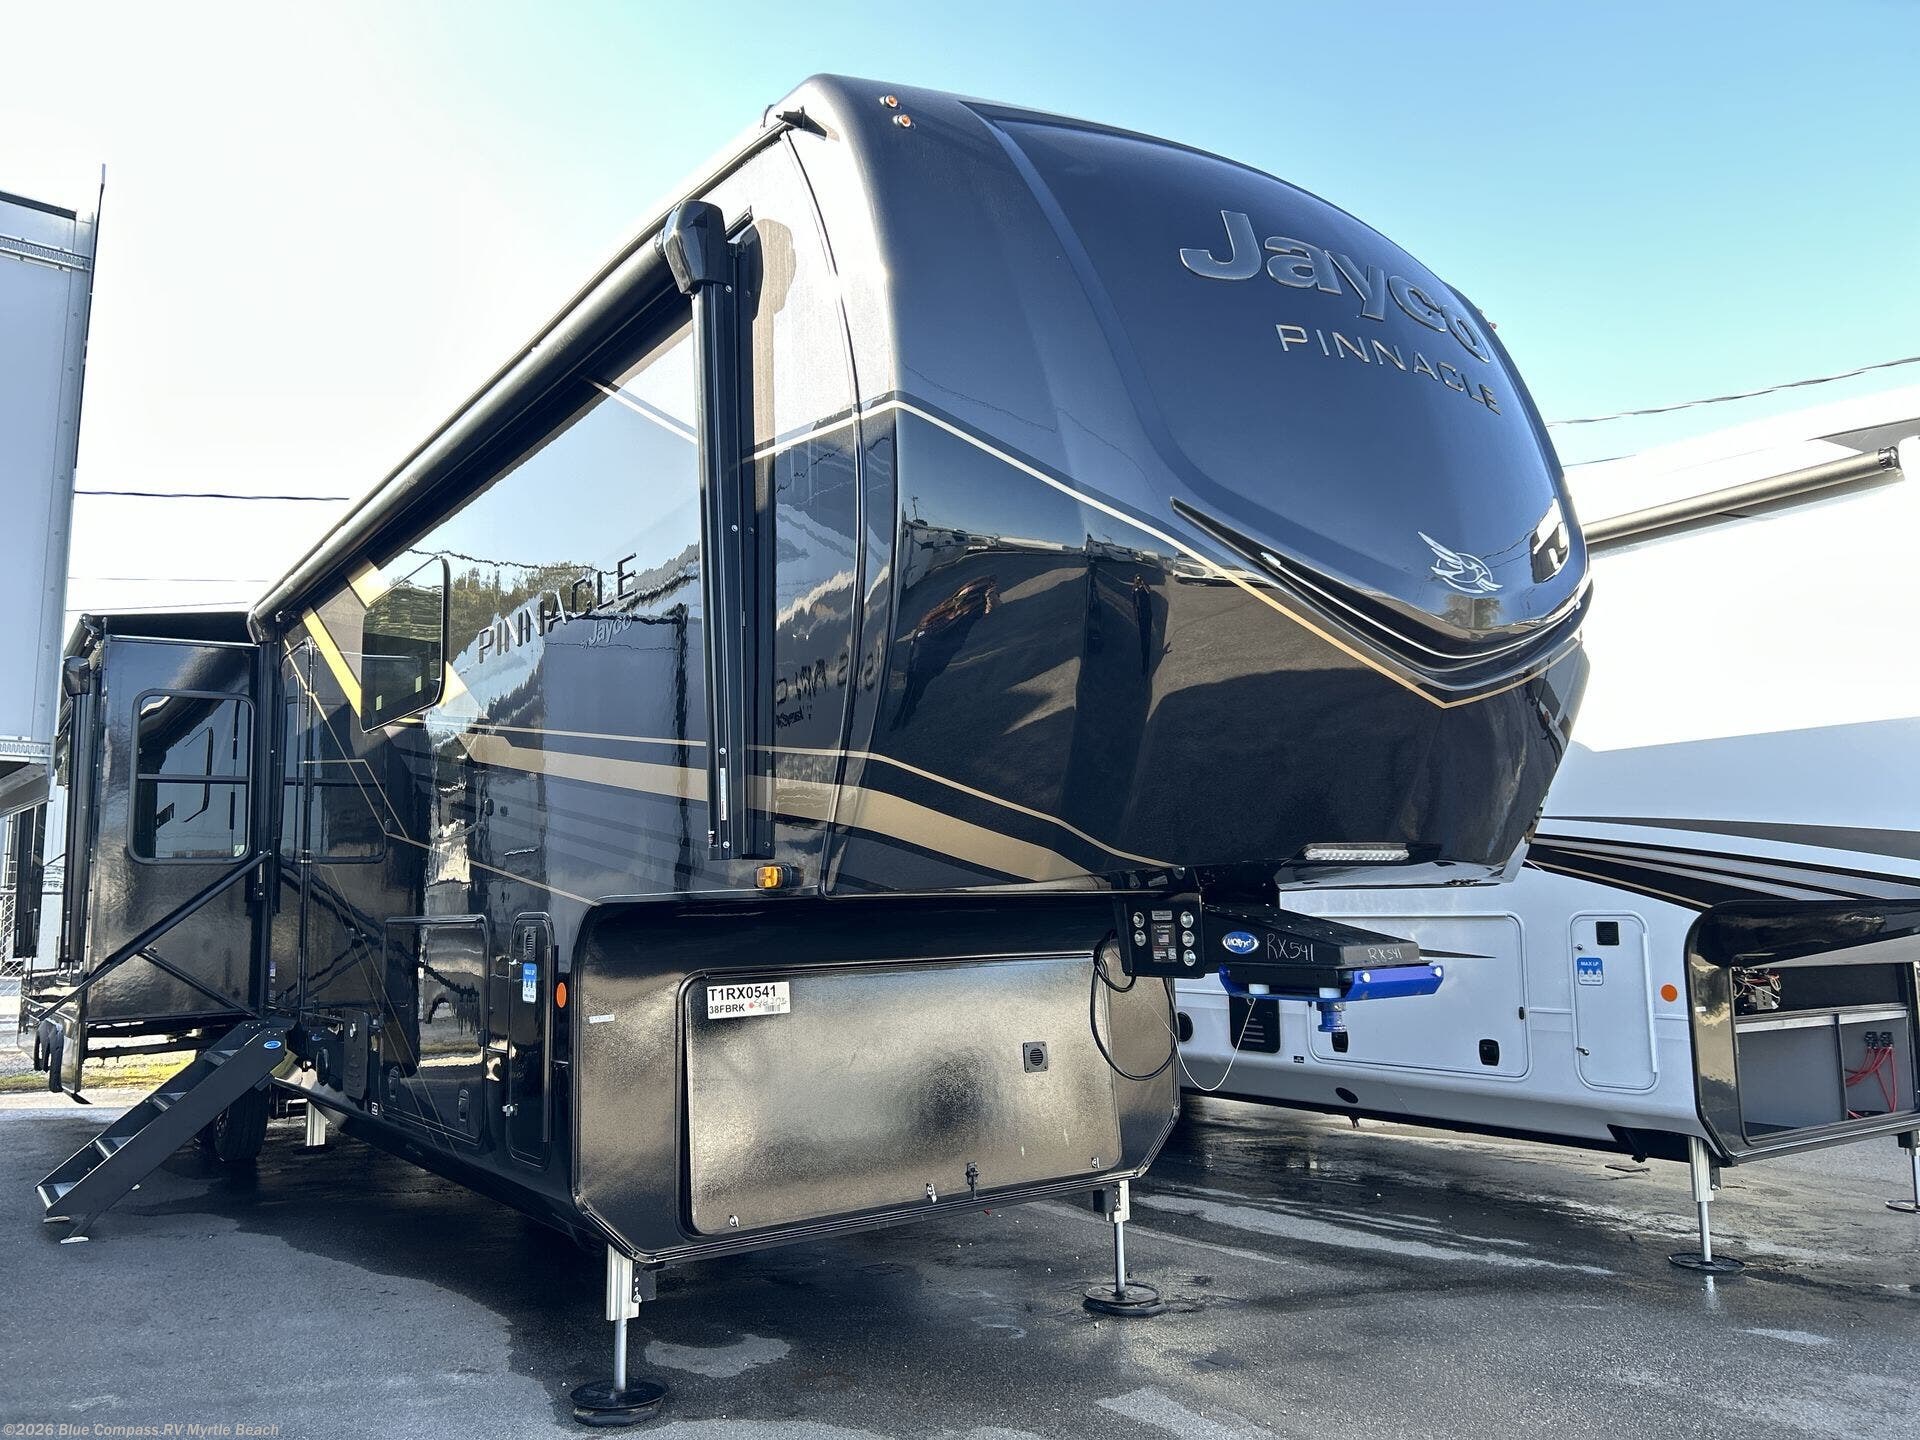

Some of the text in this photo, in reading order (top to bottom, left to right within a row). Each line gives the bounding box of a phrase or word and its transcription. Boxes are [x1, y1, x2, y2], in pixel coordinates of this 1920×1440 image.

[1179, 209, 1490, 364] Jayco
[1275, 324, 1502, 416] PINNACLE
[478, 552, 637, 664] PINNACLE
[588, 613, 633, 645] Jayco
[1266, 933, 1314, 962] RX541
[1367, 947, 1403, 960] RX541
[708, 984, 777, 1001] T1RX0541
[709, 1003, 745, 1014] 38FBRK
